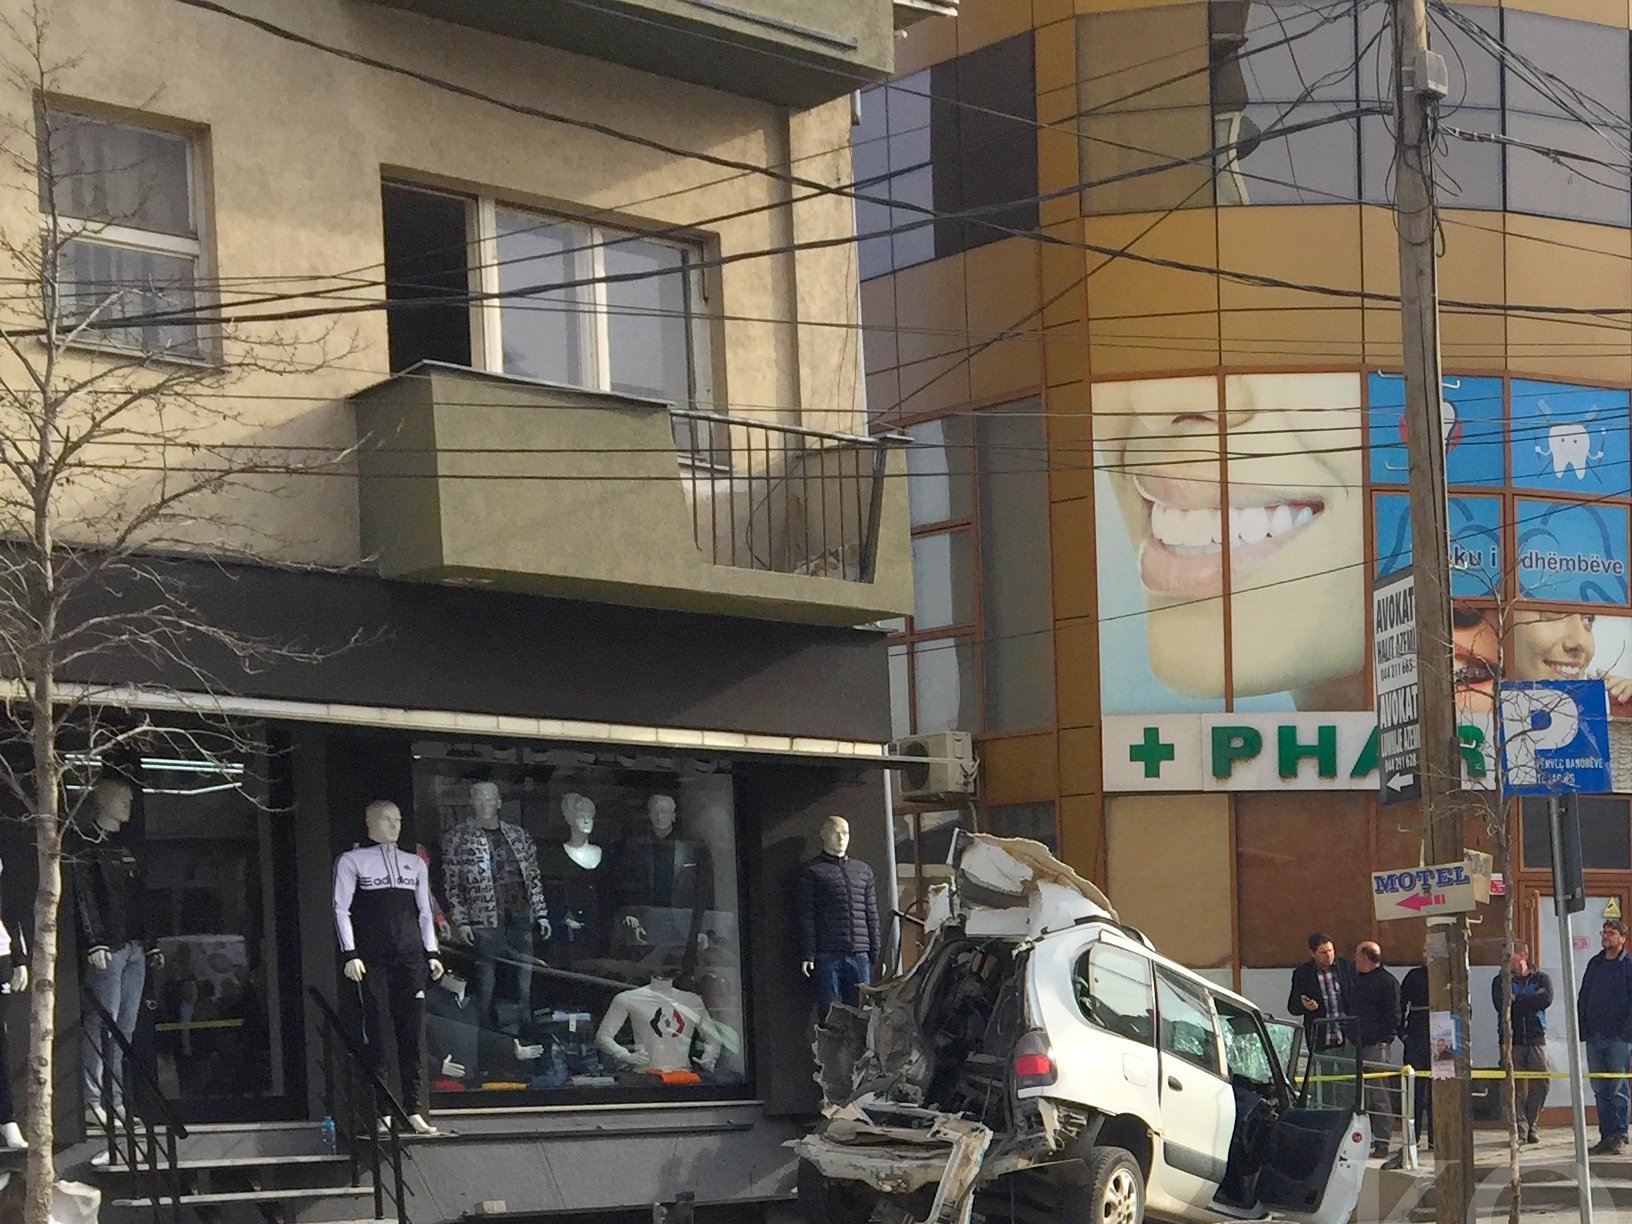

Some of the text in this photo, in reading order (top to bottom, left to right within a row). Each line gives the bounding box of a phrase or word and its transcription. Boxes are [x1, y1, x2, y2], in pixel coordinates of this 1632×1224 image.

[1522, 551, 1624, 576] dhëmbëve
[1376, 586, 1415, 635] AVOKAT
[1379, 684, 1418, 730] AVOKAT
[1374, 866, 1471, 895] MOTEL
